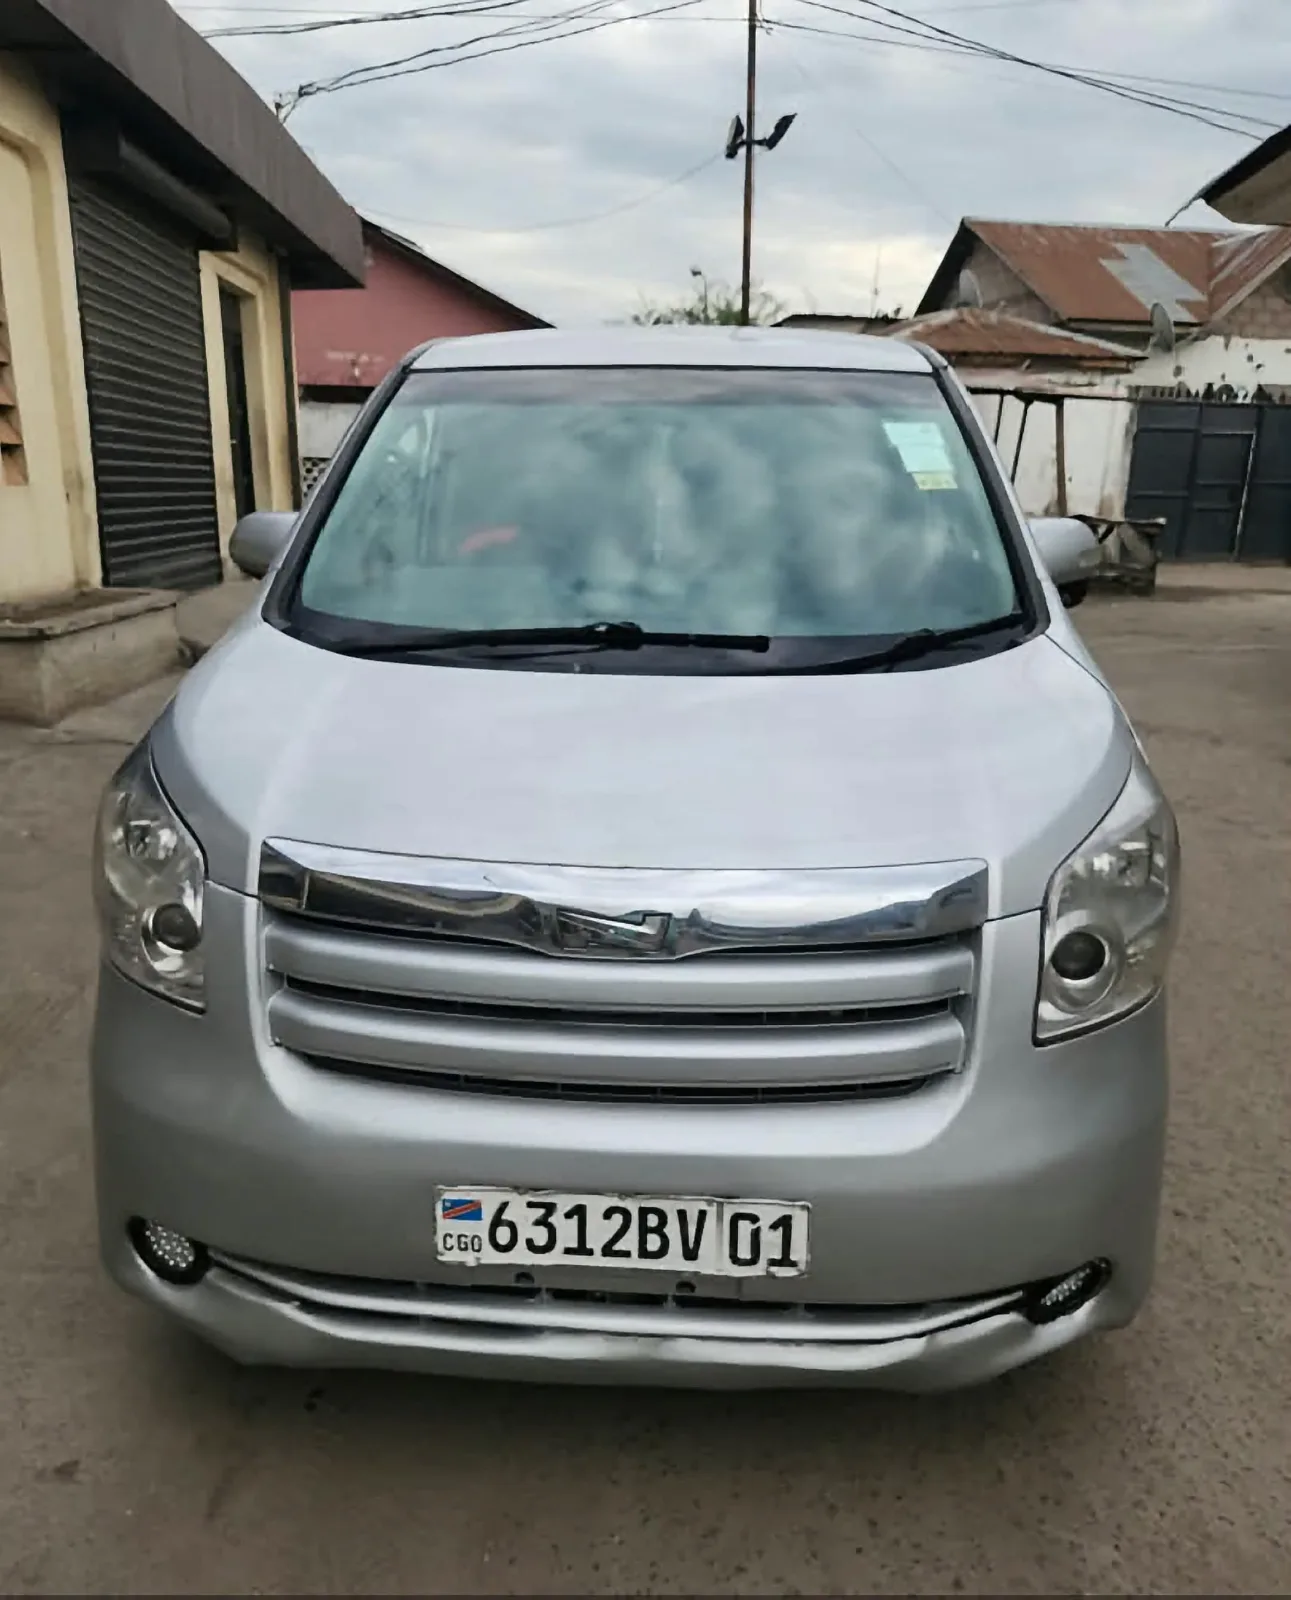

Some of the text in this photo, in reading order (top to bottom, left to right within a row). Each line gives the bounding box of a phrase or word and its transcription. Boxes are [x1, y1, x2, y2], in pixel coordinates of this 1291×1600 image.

[442, 1233, 482, 1253] CGO
[488, 1201, 798, 1267] 6312BV 01
